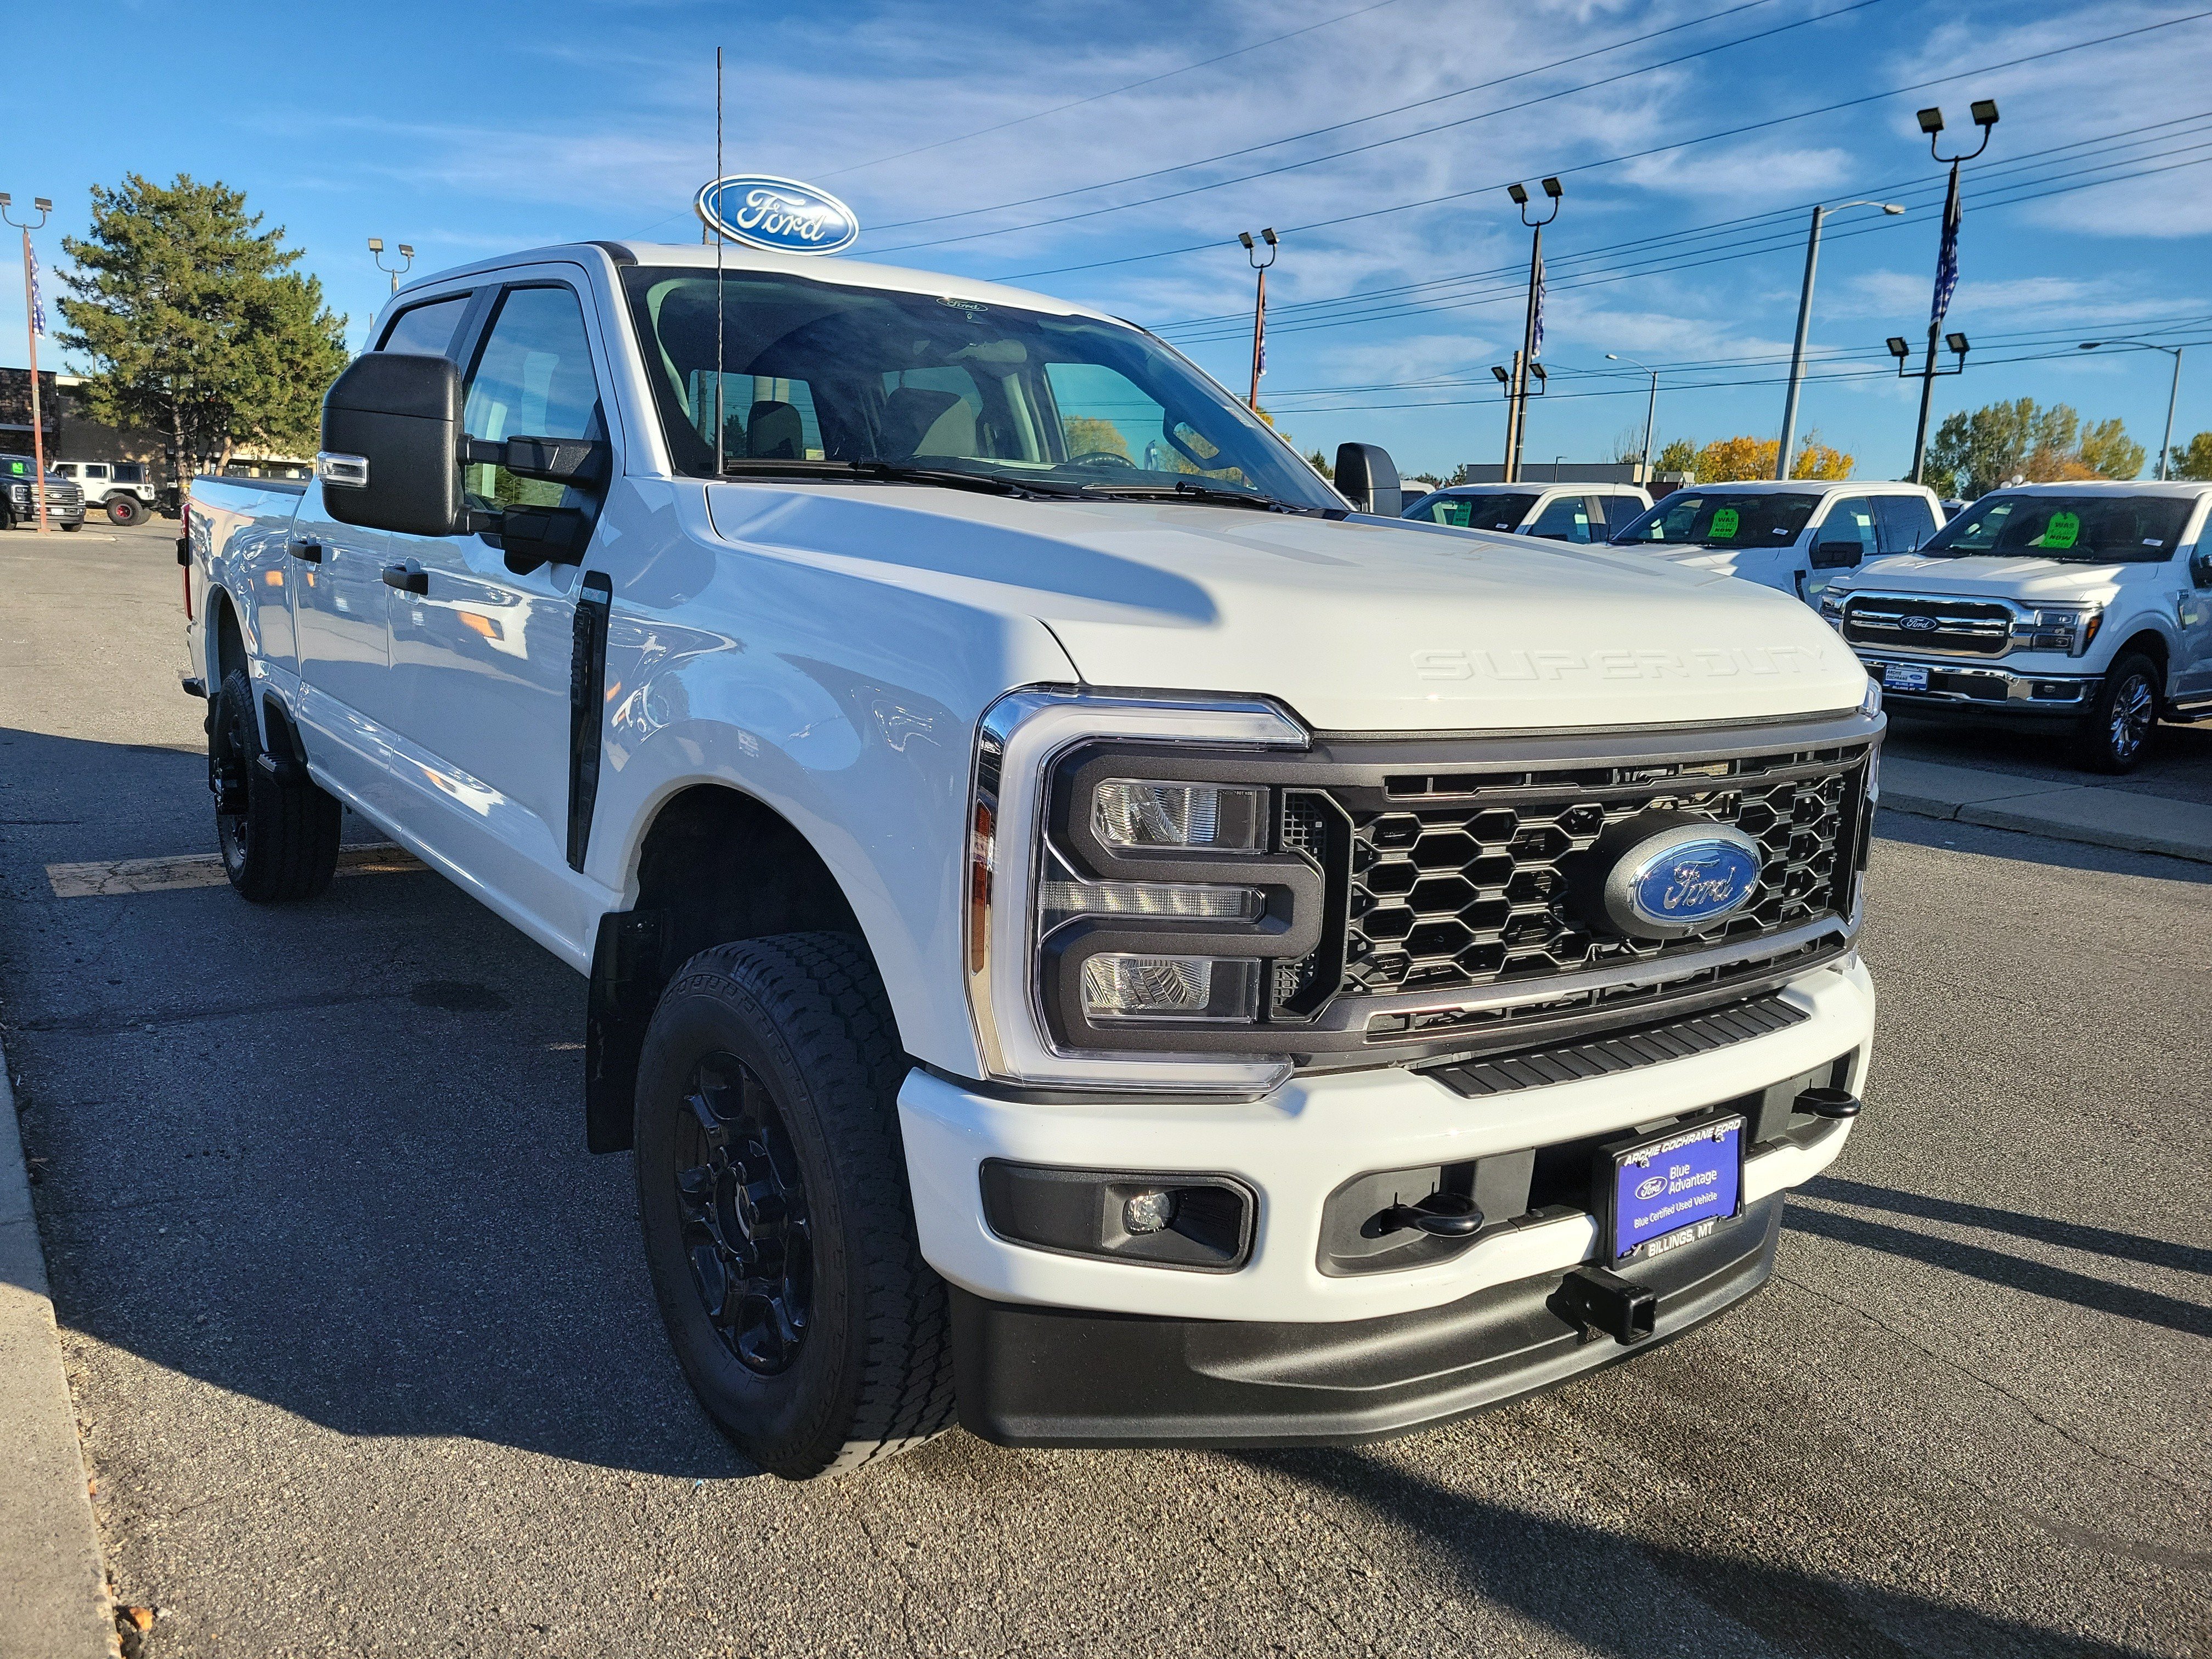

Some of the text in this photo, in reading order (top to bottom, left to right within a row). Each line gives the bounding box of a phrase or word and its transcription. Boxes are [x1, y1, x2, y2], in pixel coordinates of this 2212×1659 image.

[737, 190, 827, 241] Ford
[947, 300, 980, 310] Ford
[1906, 618, 1931, 628] Ford
[1411, 645, 1829, 680] SUPER DUTY
[1663, 858, 1736, 910] Ford
[1624, 1119, 1741, 1167] ARCHIE COCHRANE FORD
[1640, 1180, 1662, 1198] Ford
[1668, 1169, 1718, 1195] Advantage
[1669, 1164, 1690, 1180] Blue
[1633, 1191, 1718, 1229] Blue Certified Used Vehicle
[1647, 1221, 1714, 1258] BILLINGS, MT
